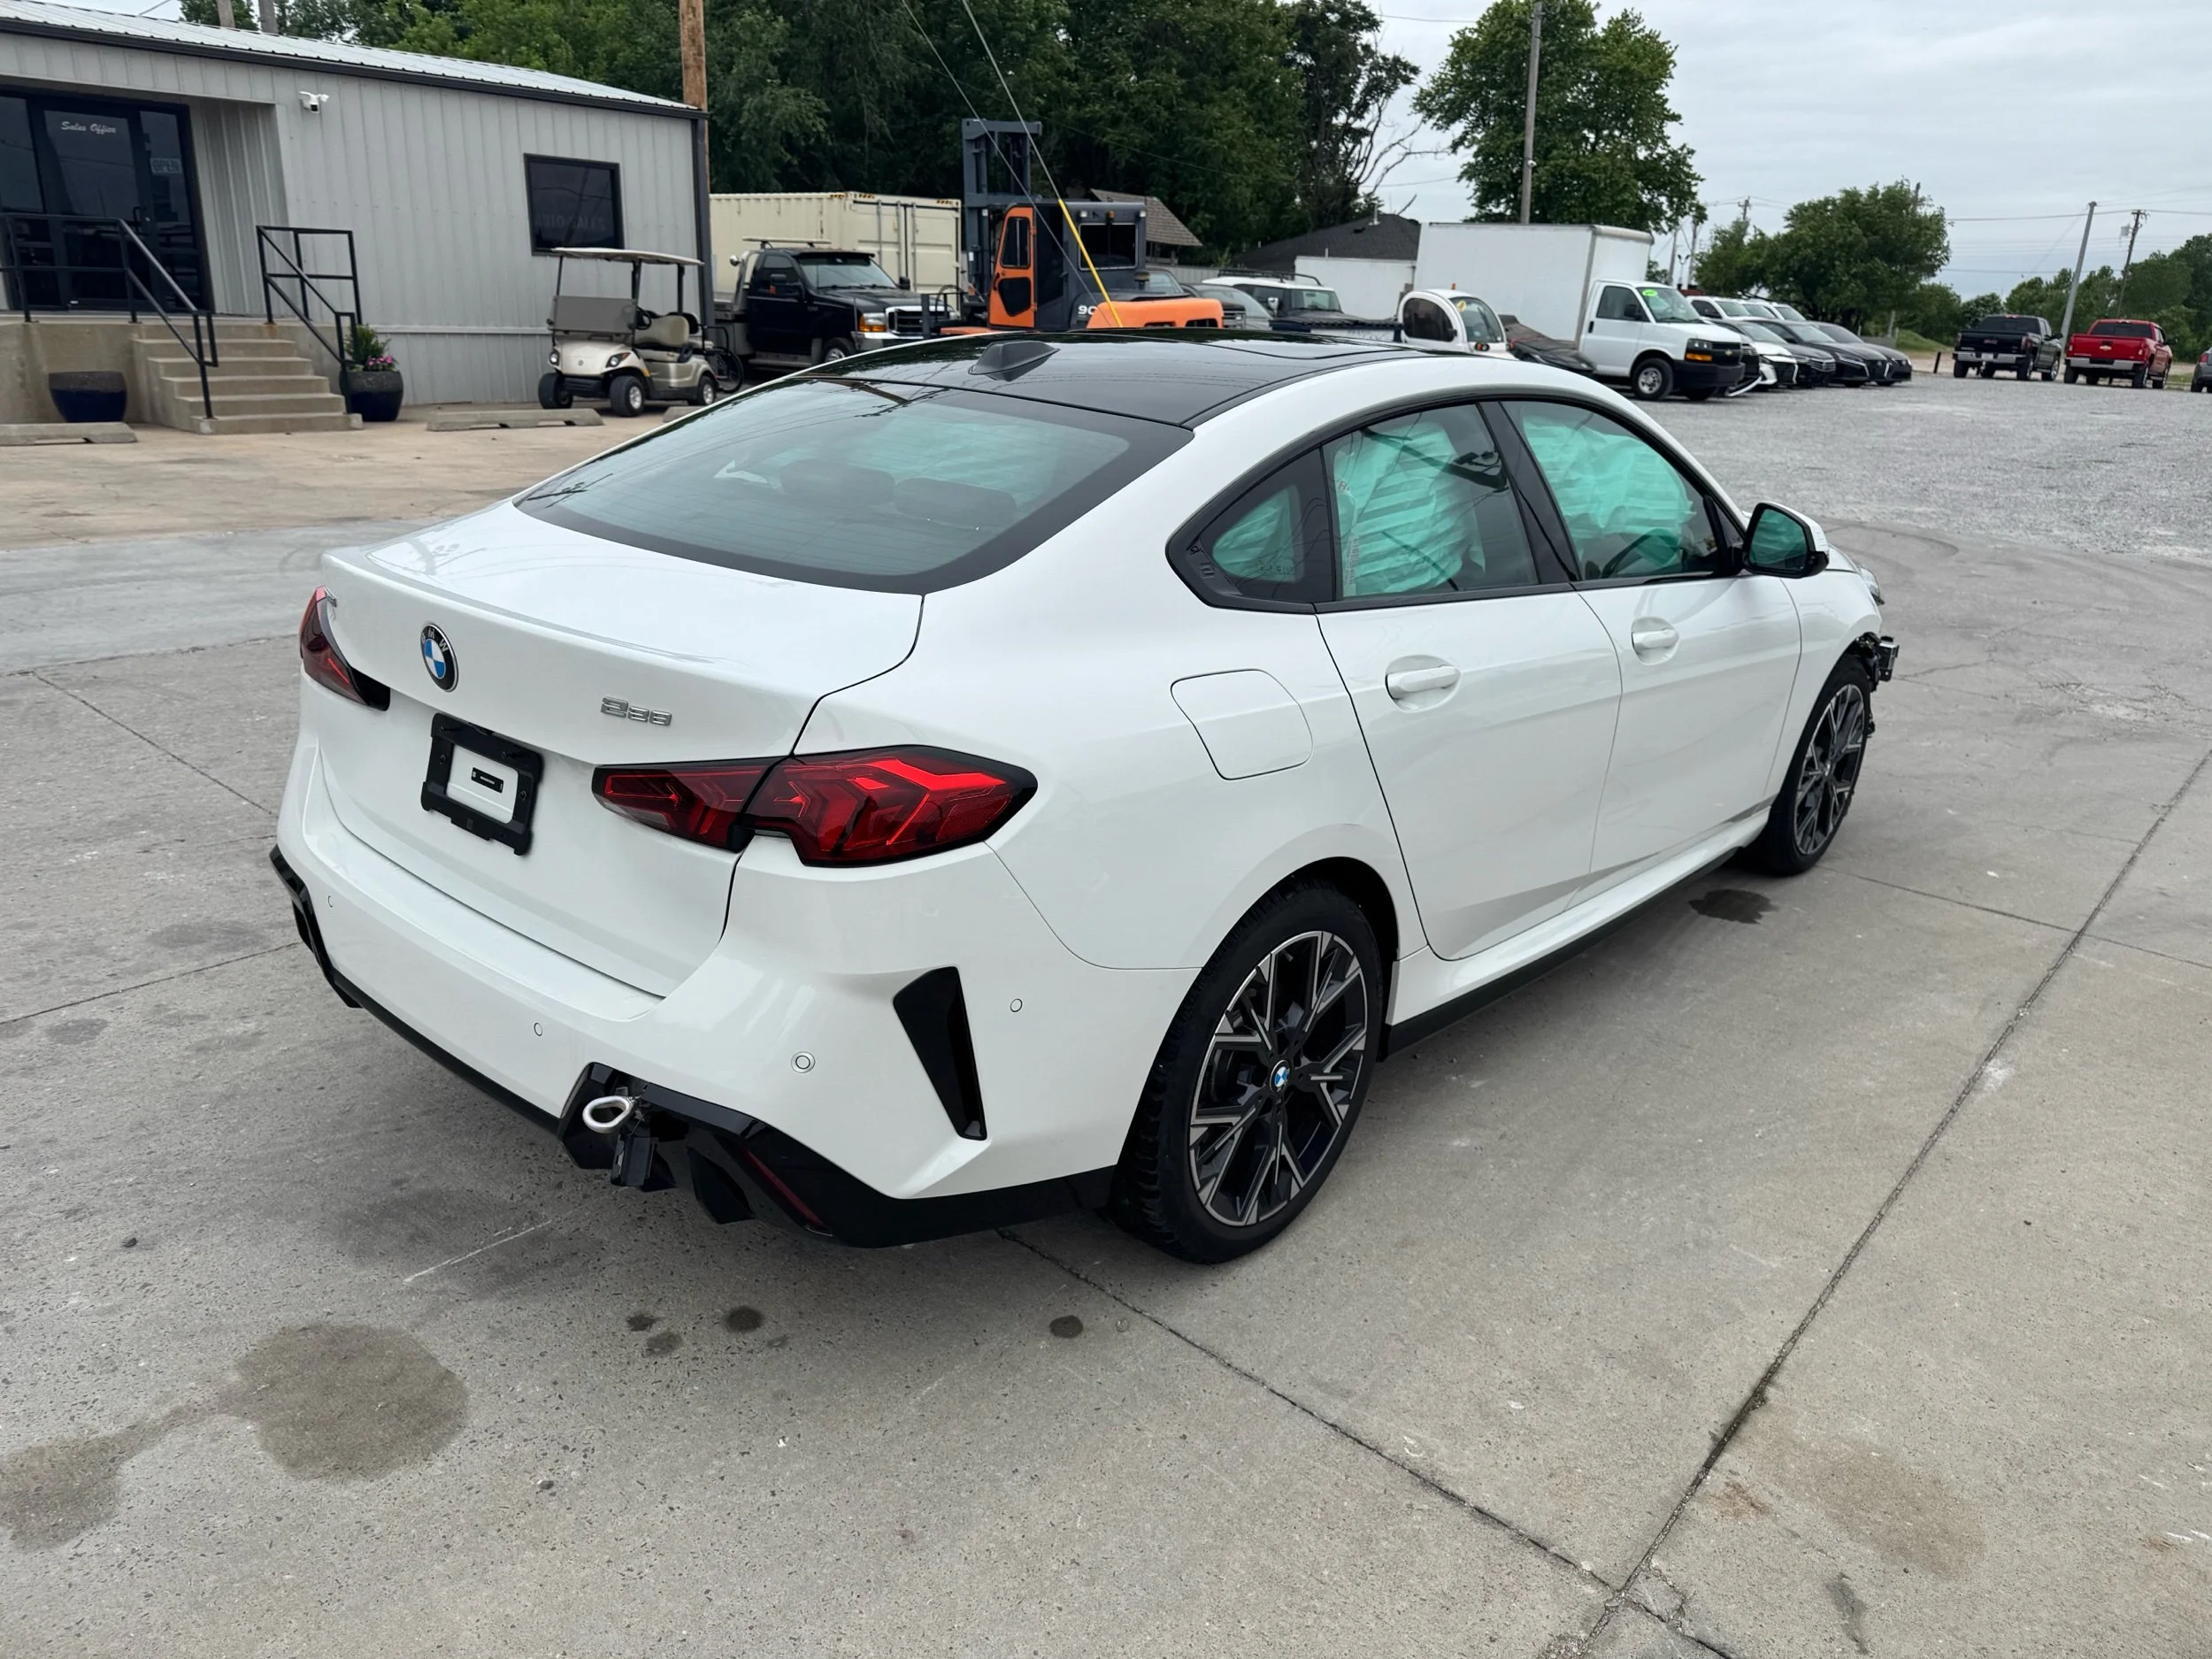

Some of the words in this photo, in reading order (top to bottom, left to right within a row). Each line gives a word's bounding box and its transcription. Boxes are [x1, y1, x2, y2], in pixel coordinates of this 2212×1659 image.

[60, 120, 87, 132] Sales
[89, 123, 117, 134] Office
[600, 695, 672, 726] 228
